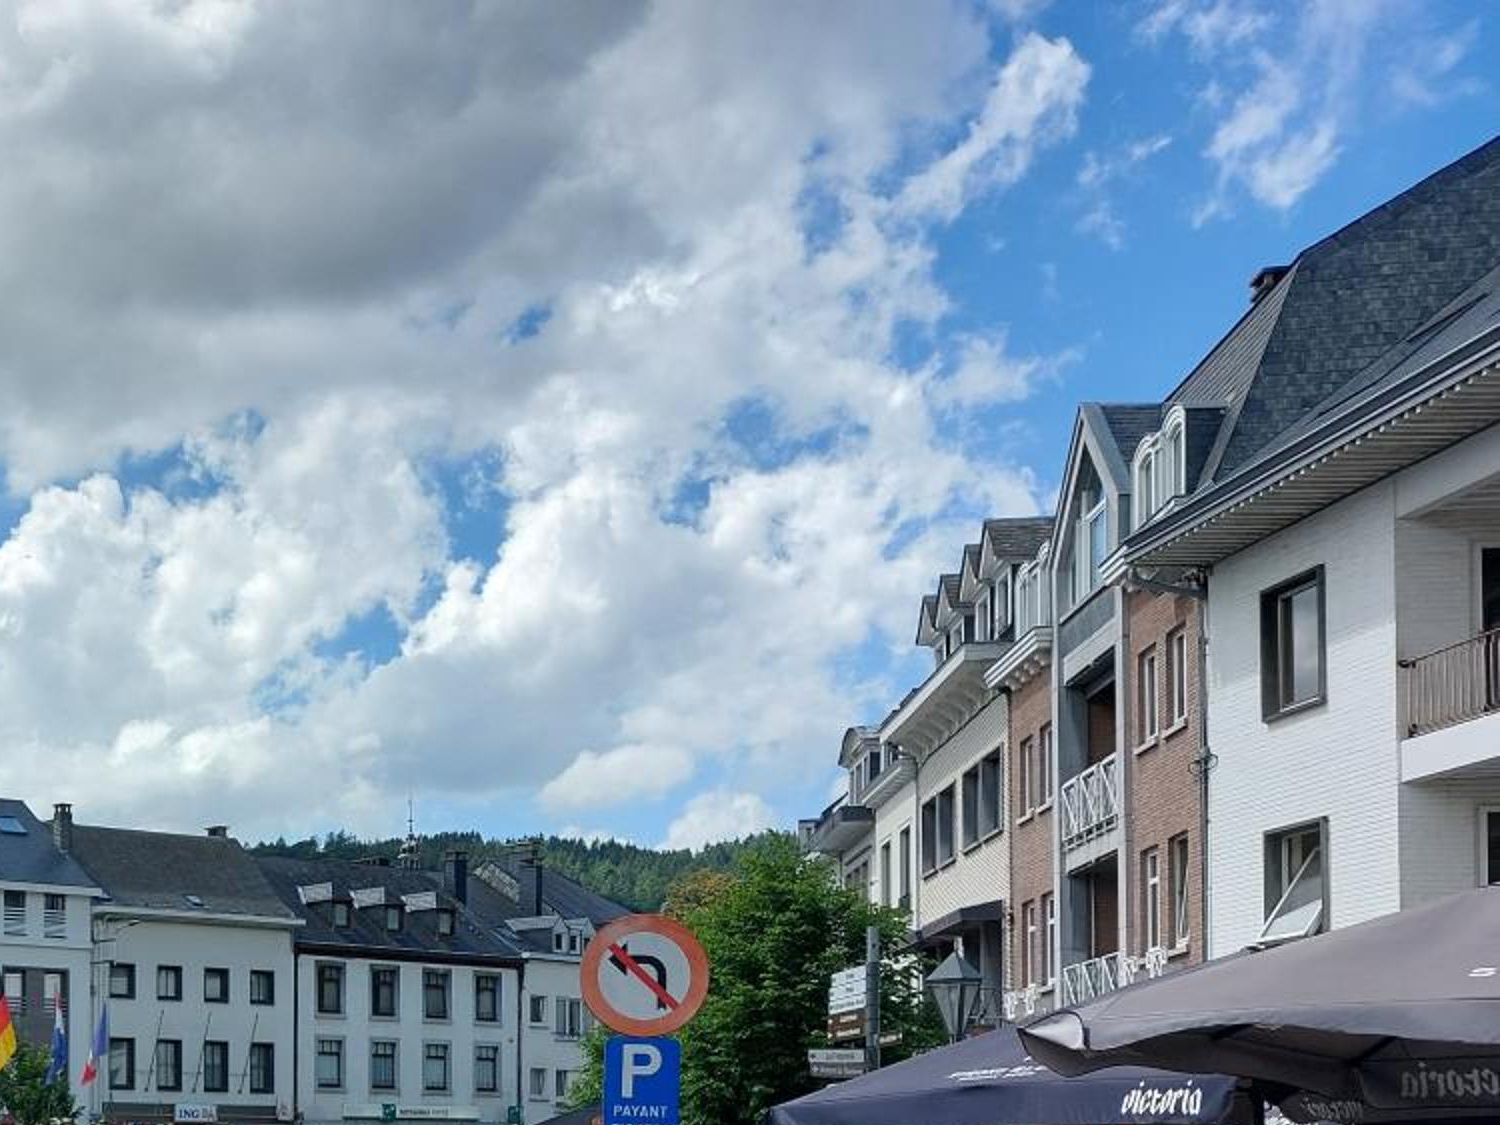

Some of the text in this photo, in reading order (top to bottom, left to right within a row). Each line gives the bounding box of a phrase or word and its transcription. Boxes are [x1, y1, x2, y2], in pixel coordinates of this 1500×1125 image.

[622, 1043, 662, 1098] P
[1121, 1080, 1203, 1116] victoria
[180, 1109, 199, 1119] ING
[613, 1105, 668, 1118] PAYANT
